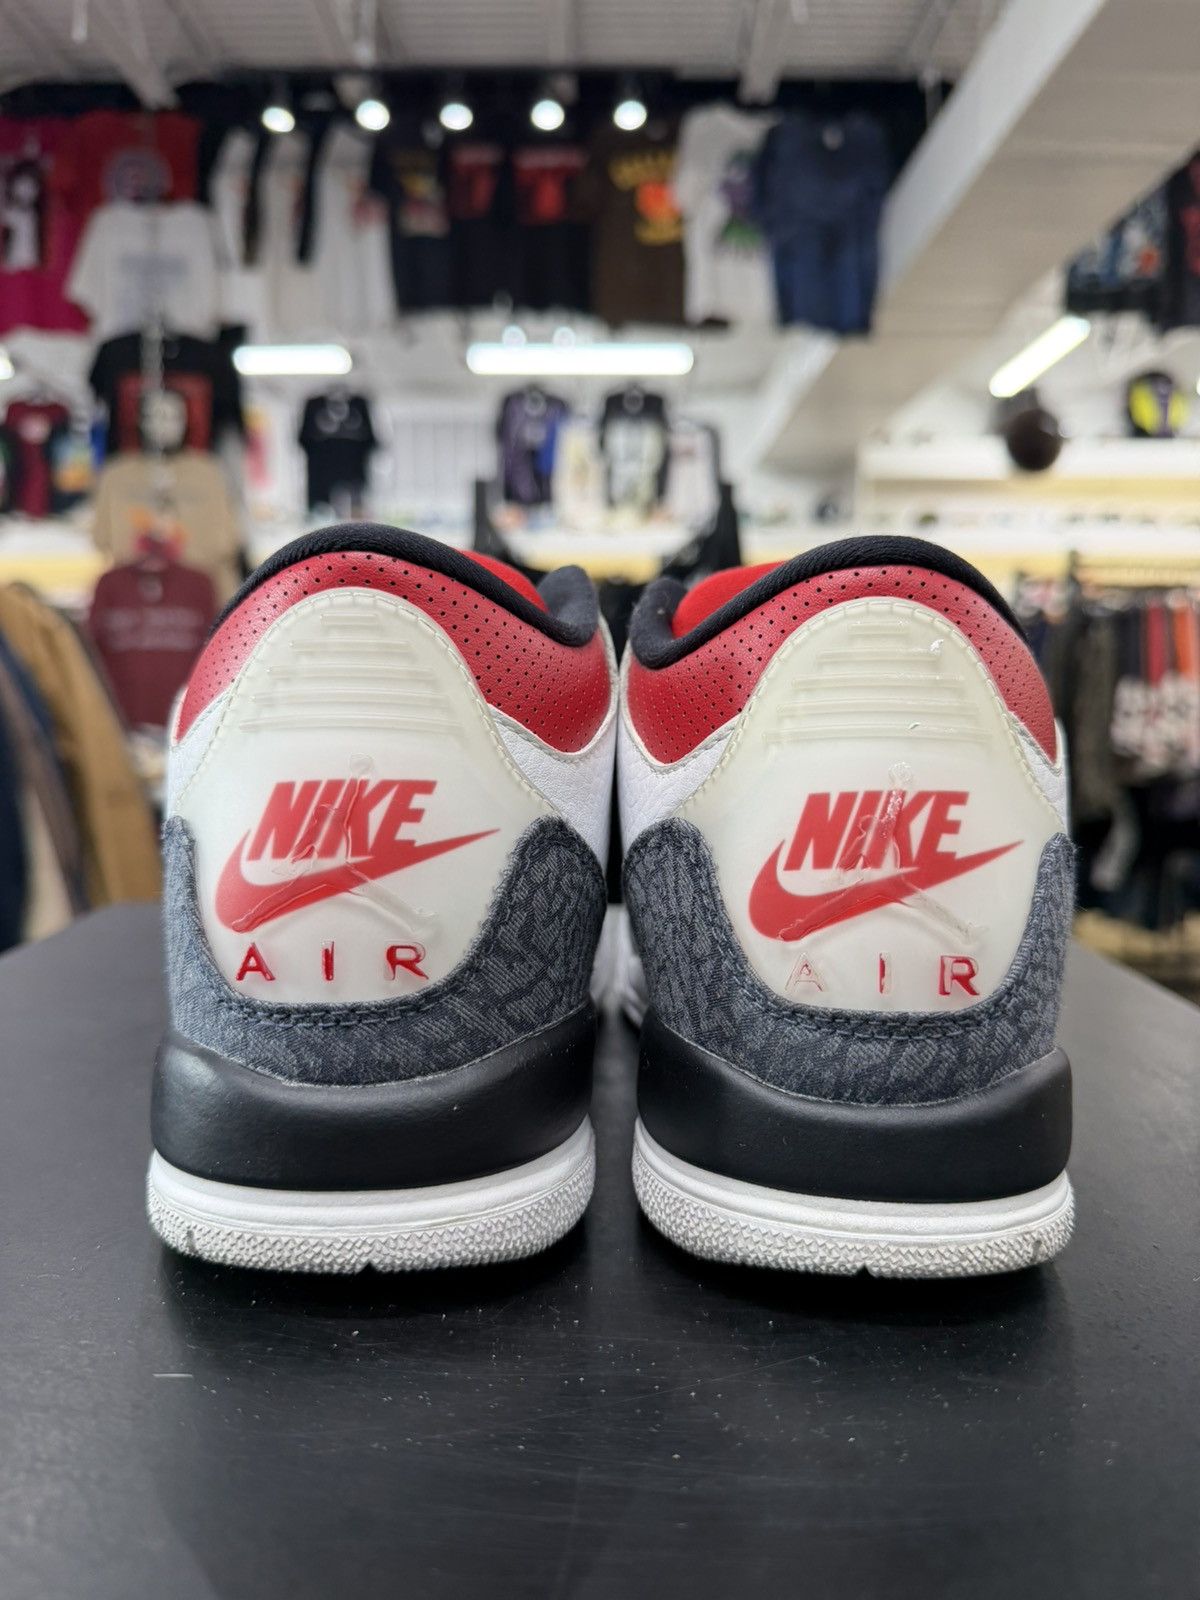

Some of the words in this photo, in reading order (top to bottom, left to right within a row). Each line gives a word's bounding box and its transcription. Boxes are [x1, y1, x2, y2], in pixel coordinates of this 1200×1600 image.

[246, 778, 438, 861] NIKE
[783, 790, 970, 872] NIKE
[236, 941, 429, 981] AIR
[785, 952, 980, 996] AIR
